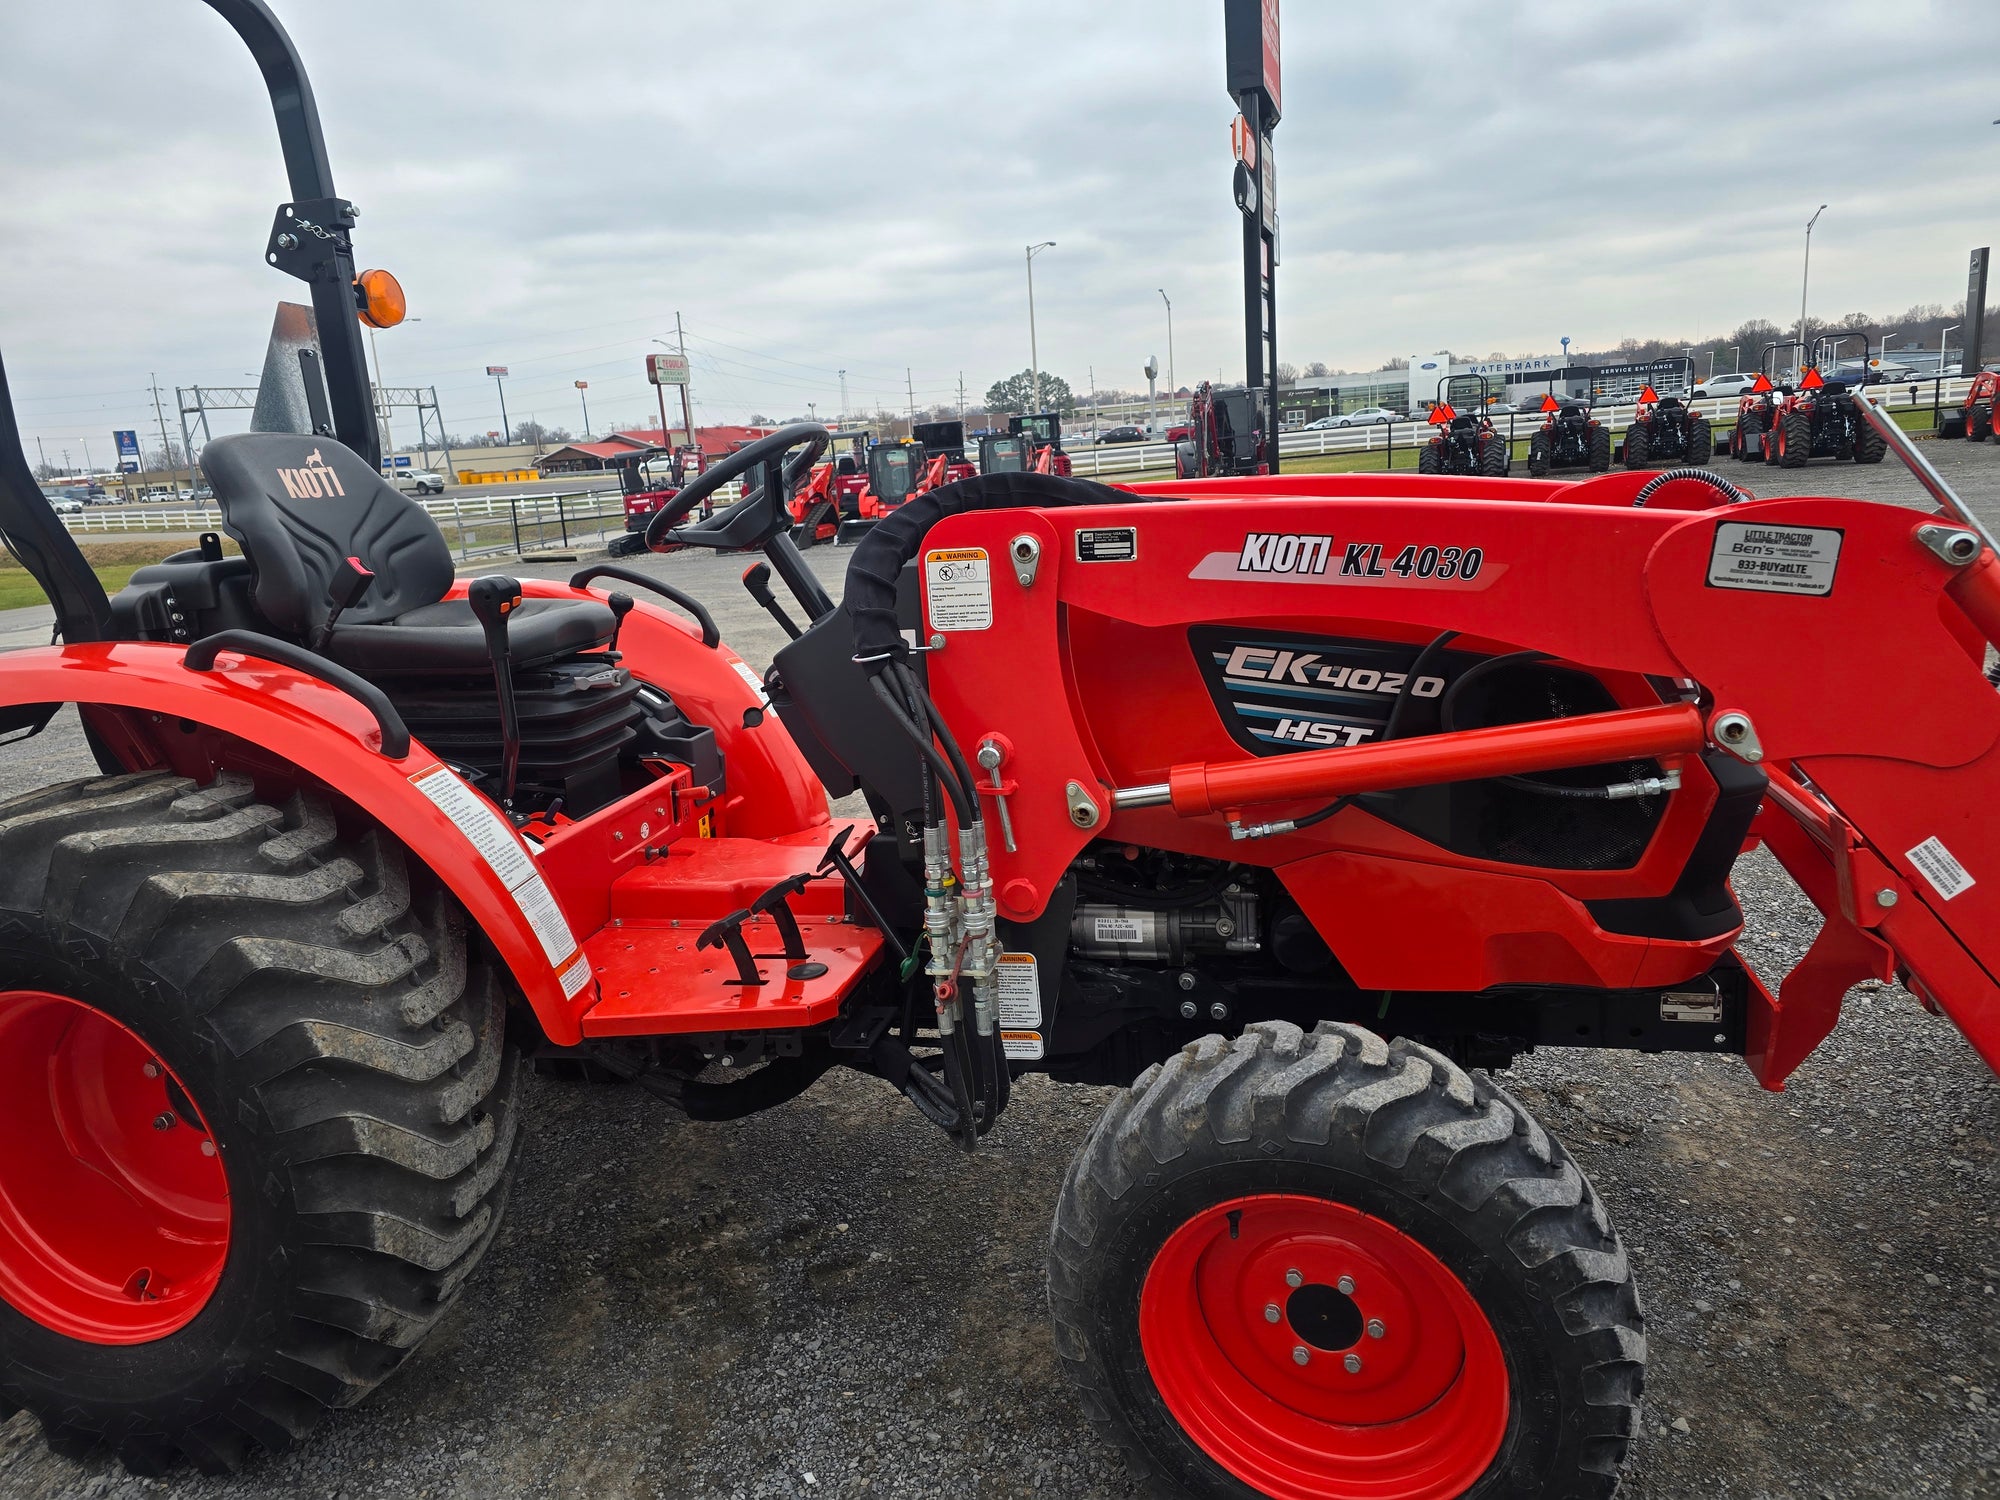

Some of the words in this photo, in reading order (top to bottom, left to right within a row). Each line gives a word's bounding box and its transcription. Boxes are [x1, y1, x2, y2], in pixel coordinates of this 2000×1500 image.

[1469, 359, 1551, 374] WATERMARK
[276, 466, 346, 499] KIOTI
[1745, 530, 1773, 540] LITTLE
[1775, 532, 1813, 542] TRACTOR
[1237, 532, 1334, 575] KIOTI
[1340, 543, 1386, 578] KL
[1391, 545, 1484, 581] 4030
[1272, 718, 1375, 747] HST
